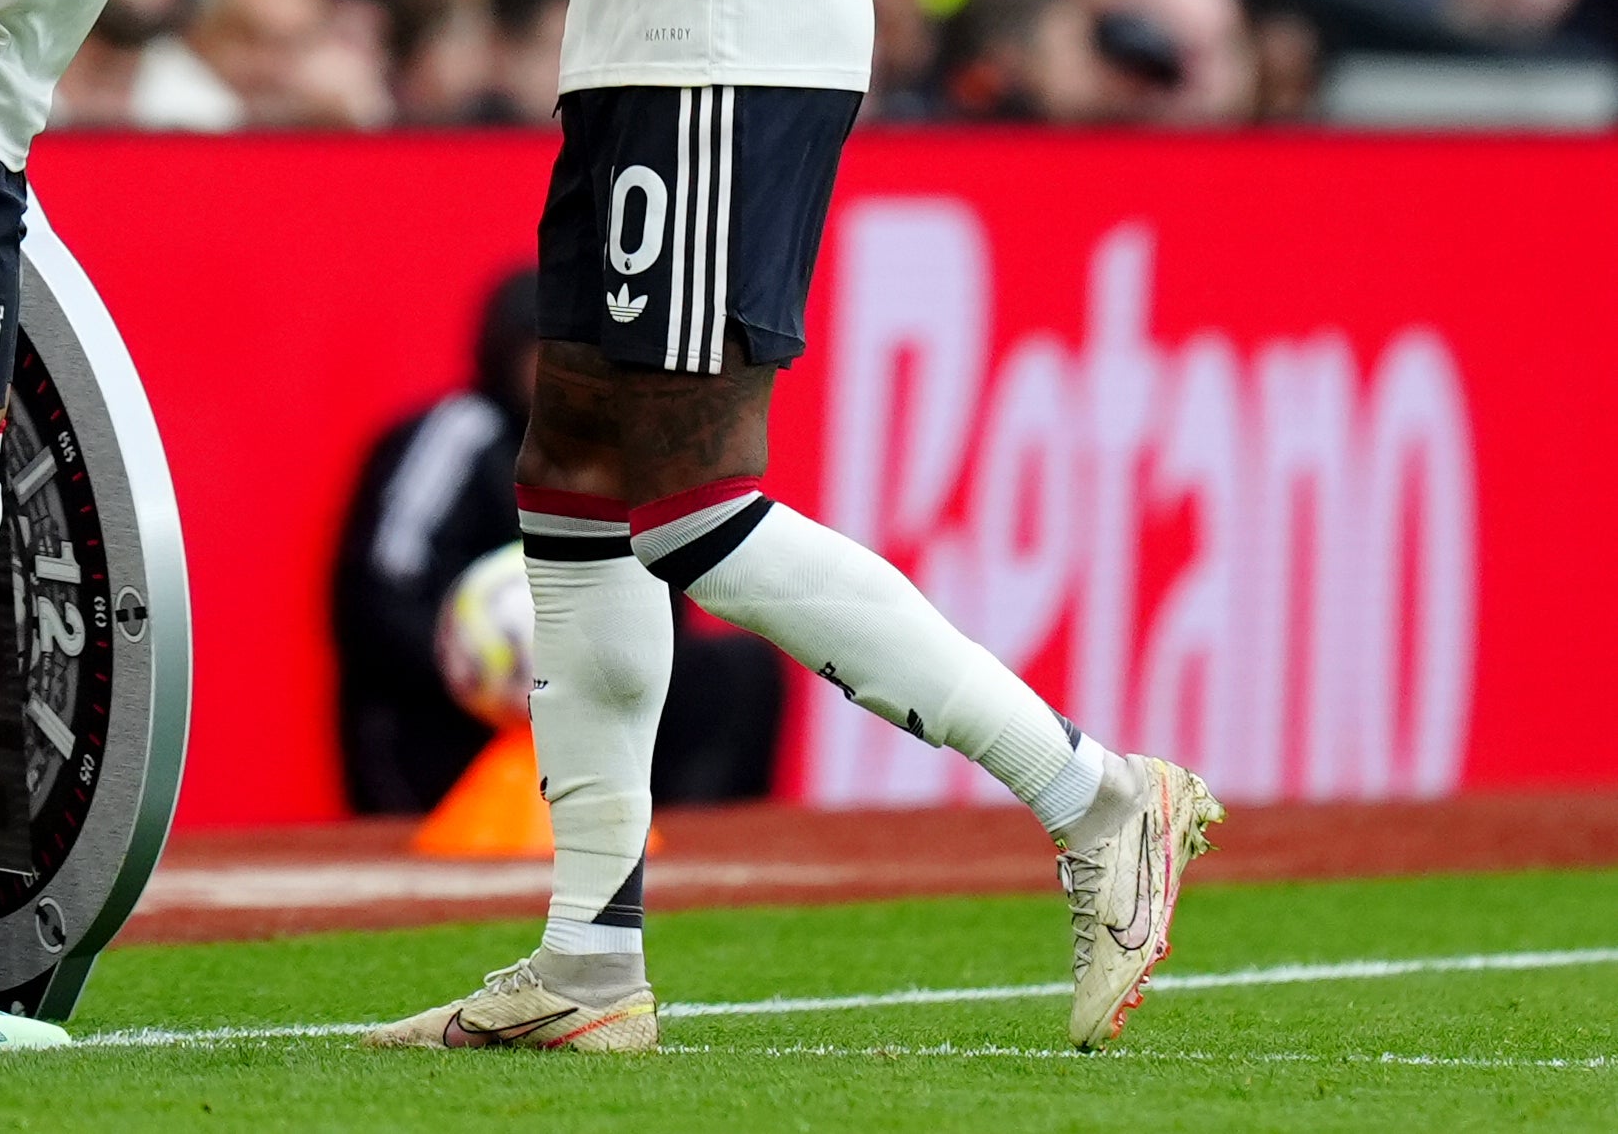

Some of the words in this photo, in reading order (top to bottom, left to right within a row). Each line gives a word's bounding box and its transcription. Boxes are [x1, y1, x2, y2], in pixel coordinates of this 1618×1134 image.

[603, 165, 668, 275] 0
[807, 196, 1478, 808] Betano
[34, 540, 86, 658] 12
